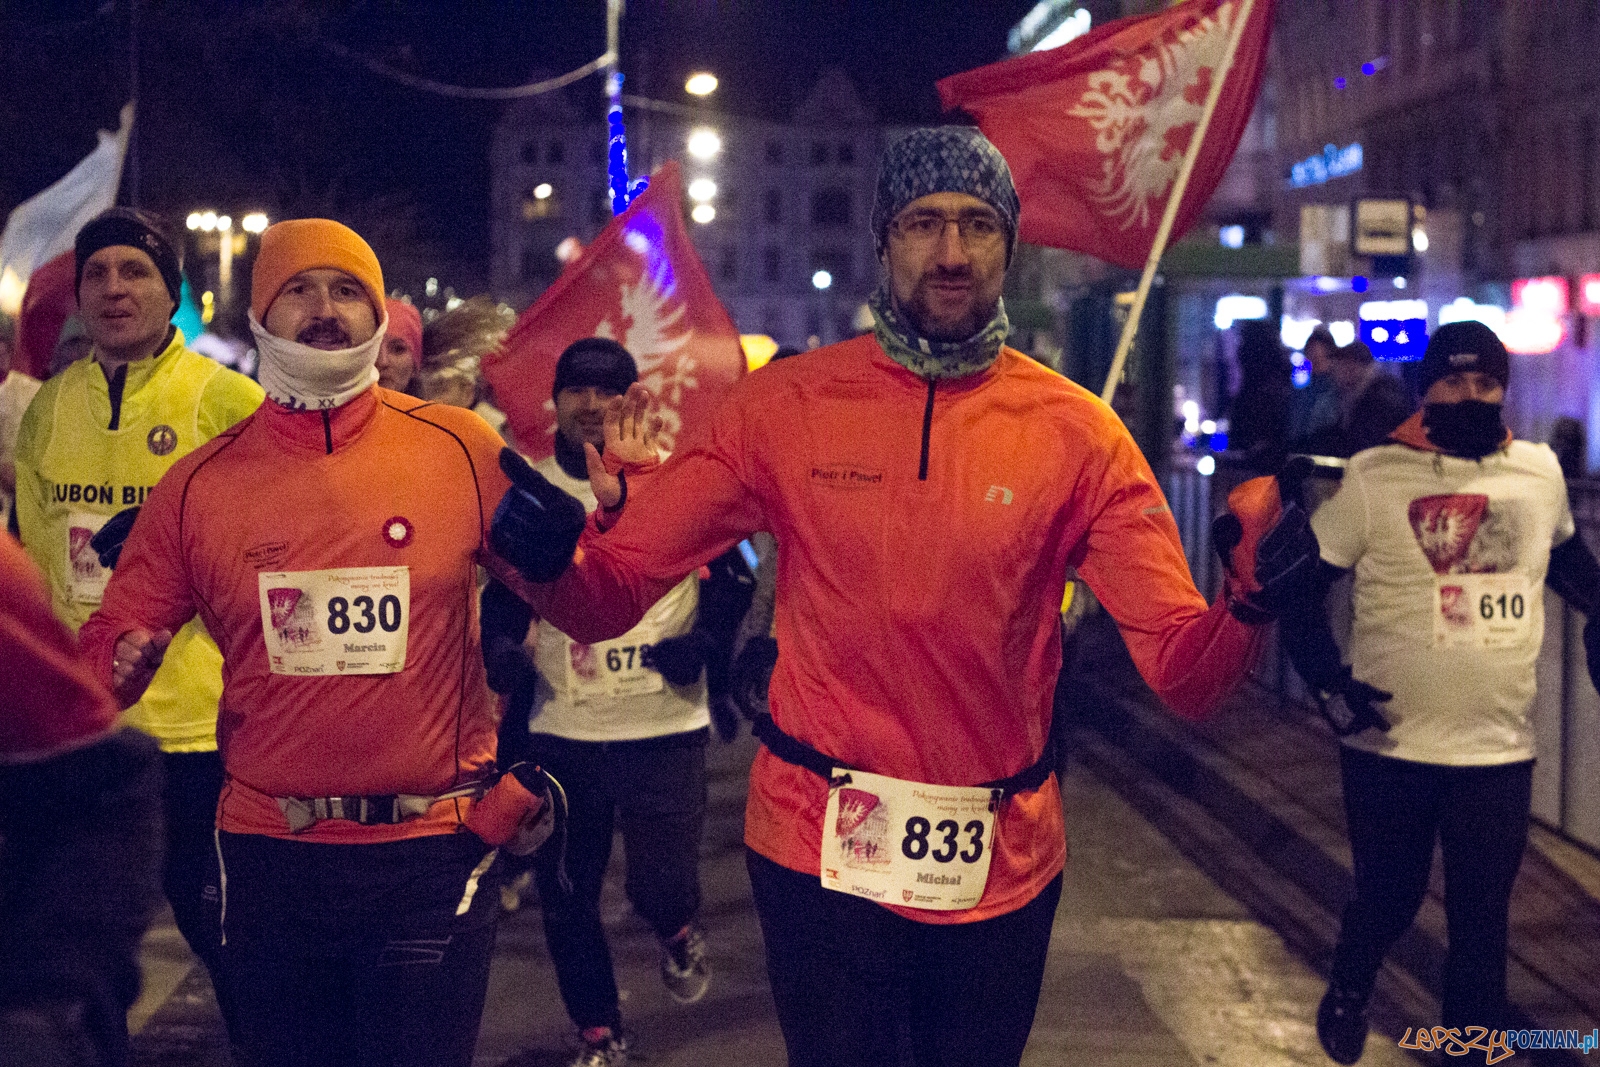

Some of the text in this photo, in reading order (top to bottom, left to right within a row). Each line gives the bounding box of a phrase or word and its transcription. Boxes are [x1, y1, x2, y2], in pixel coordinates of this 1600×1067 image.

[327, 594, 402, 635] 830
[1480, 594, 1525, 619] 610
[343, 643, 387, 653] Marcin
[901, 816, 985, 864] 833
